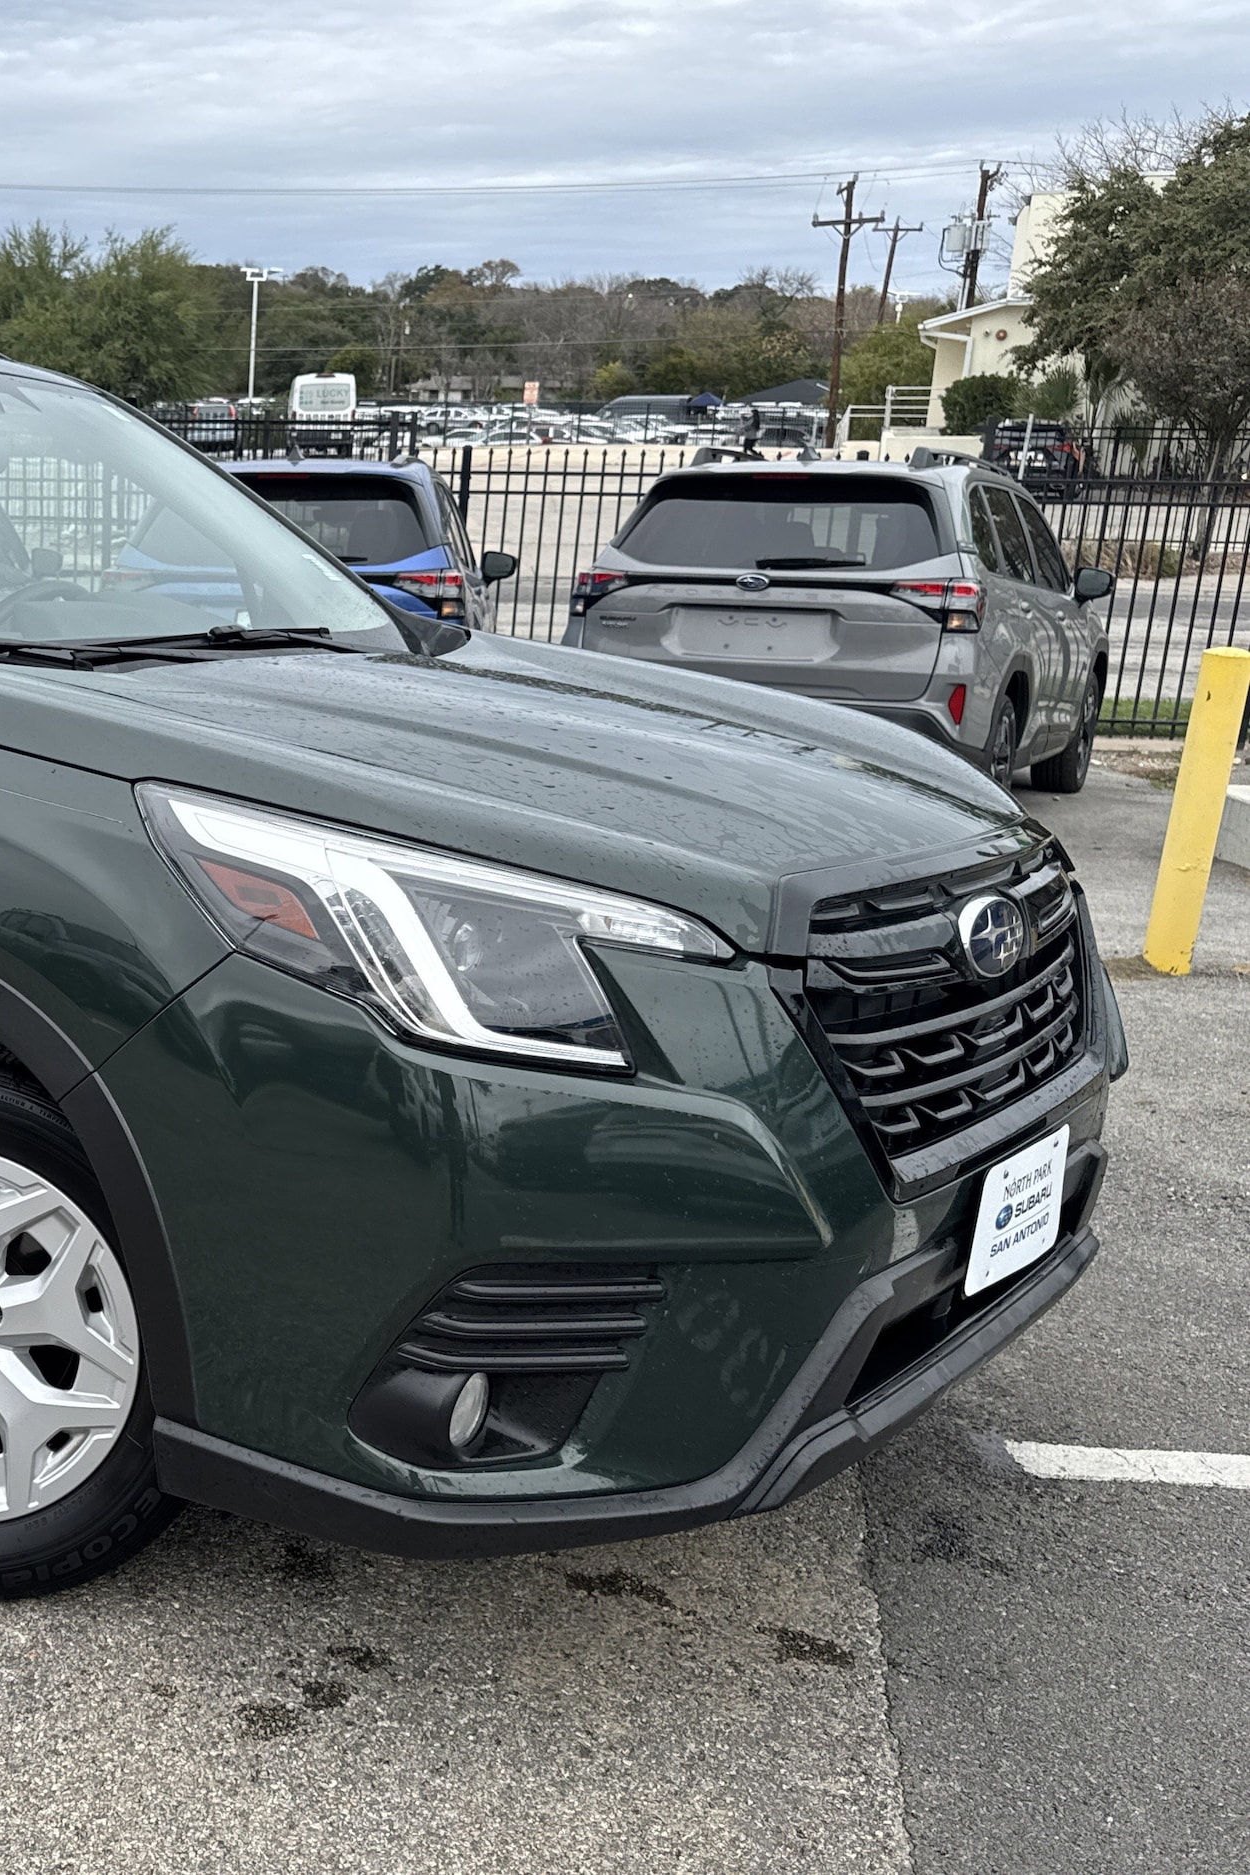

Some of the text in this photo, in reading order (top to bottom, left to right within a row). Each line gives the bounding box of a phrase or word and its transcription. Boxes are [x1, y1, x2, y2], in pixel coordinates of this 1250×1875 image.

[316, 388, 349, 398] LUCKY
[1003, 1159, 1053, 1202] NORTH PARK
[1014, 1182, 1052, 1218] SUBARU
[990, 1212, 1049, 1258] SAN ANTONIO
